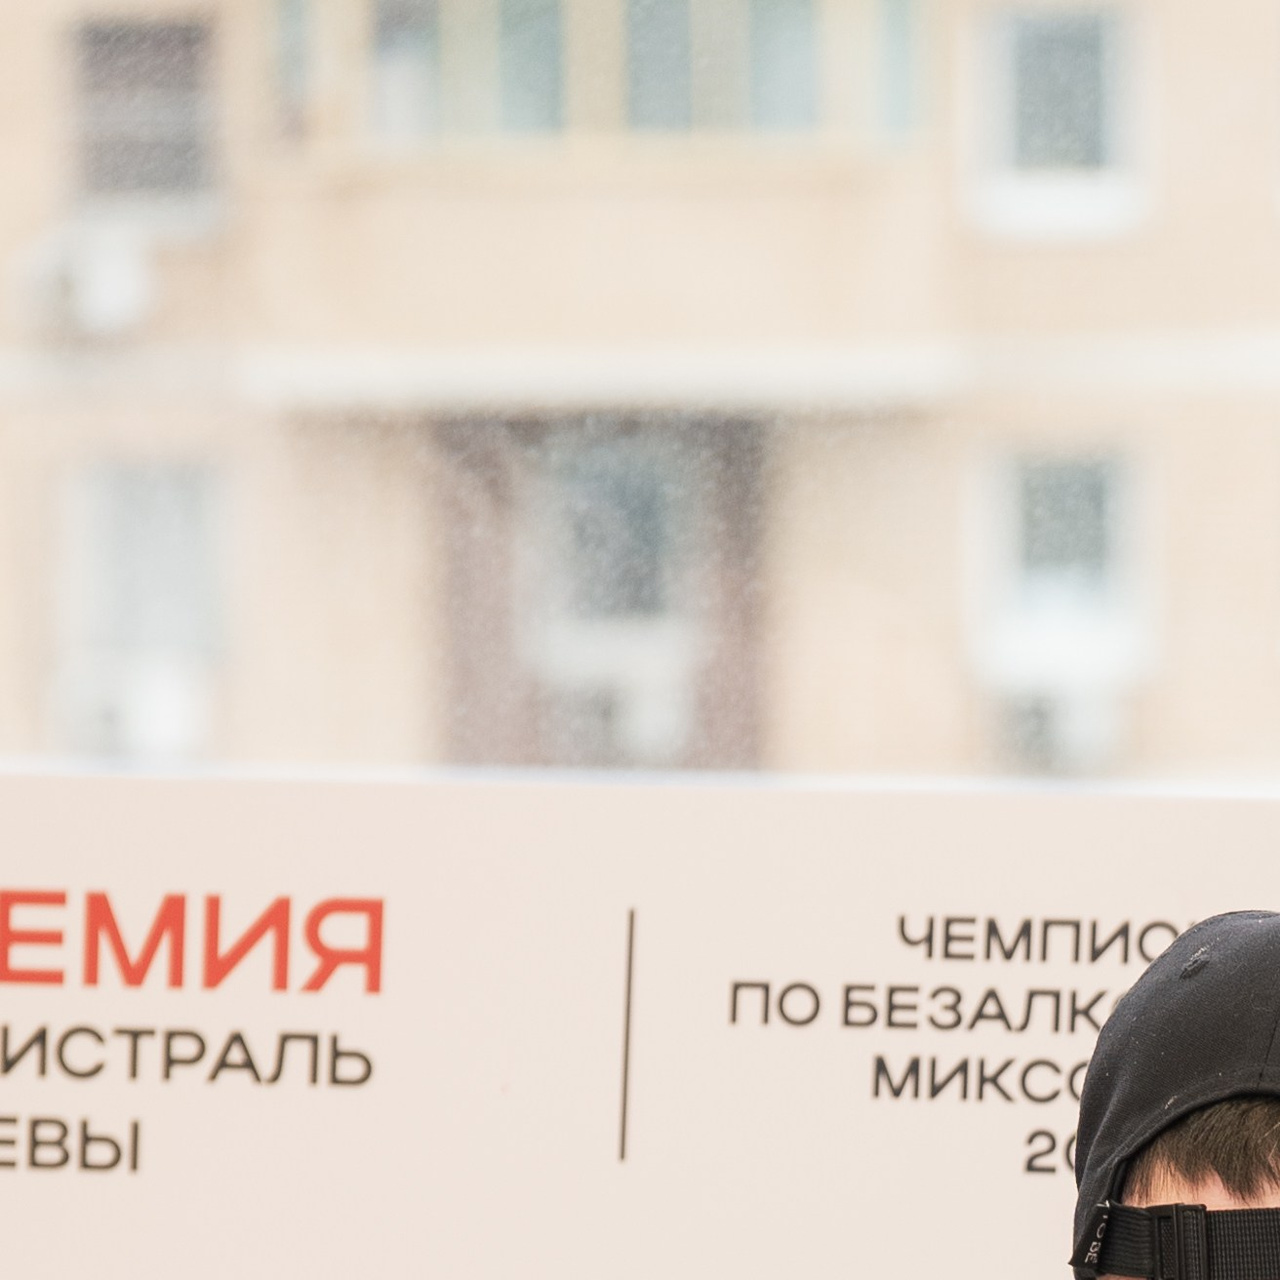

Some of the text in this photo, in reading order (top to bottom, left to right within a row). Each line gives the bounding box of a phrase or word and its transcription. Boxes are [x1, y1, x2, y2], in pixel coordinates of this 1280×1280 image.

[0, 889, 385, 996] ЕМИЯ
[899, 914, 1196, 965] ЧЕМПИО
[729, 980, 1128, 1034] ПО БЕЗАЛК
[1, 1023, 374, 1088] ИСТРАЛЬ
[1024, 1129, 1076, 1174] 2
